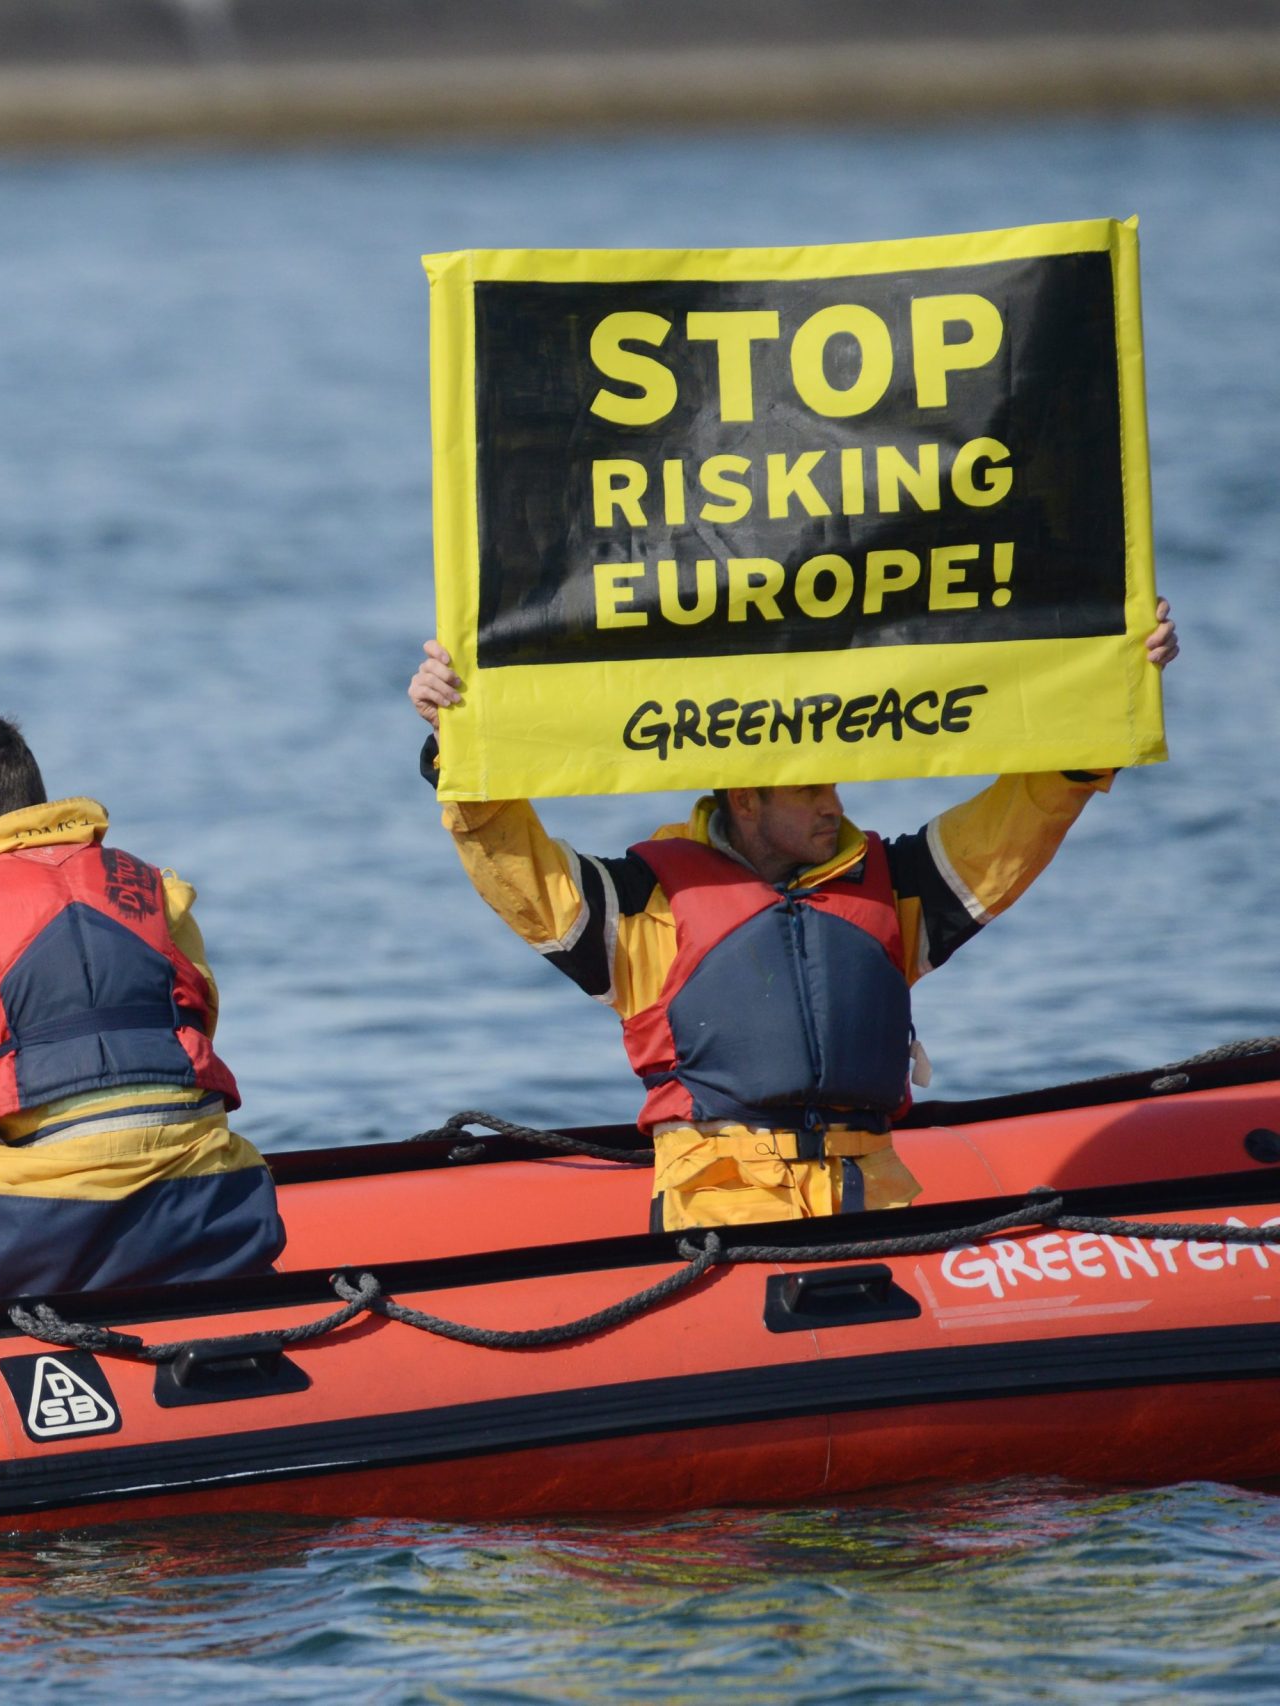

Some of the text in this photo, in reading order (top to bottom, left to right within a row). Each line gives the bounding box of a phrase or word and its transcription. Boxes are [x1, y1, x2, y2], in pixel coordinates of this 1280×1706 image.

[589, 293, 1004, 427] STOP
[590, 436, 1014, 529] RISKING
[592, 540, 1016, 630] EUROPE!
[622, 684, 989, 760] GREENPEACE
[939, 1216, 1280, 1298] GREENPEA
